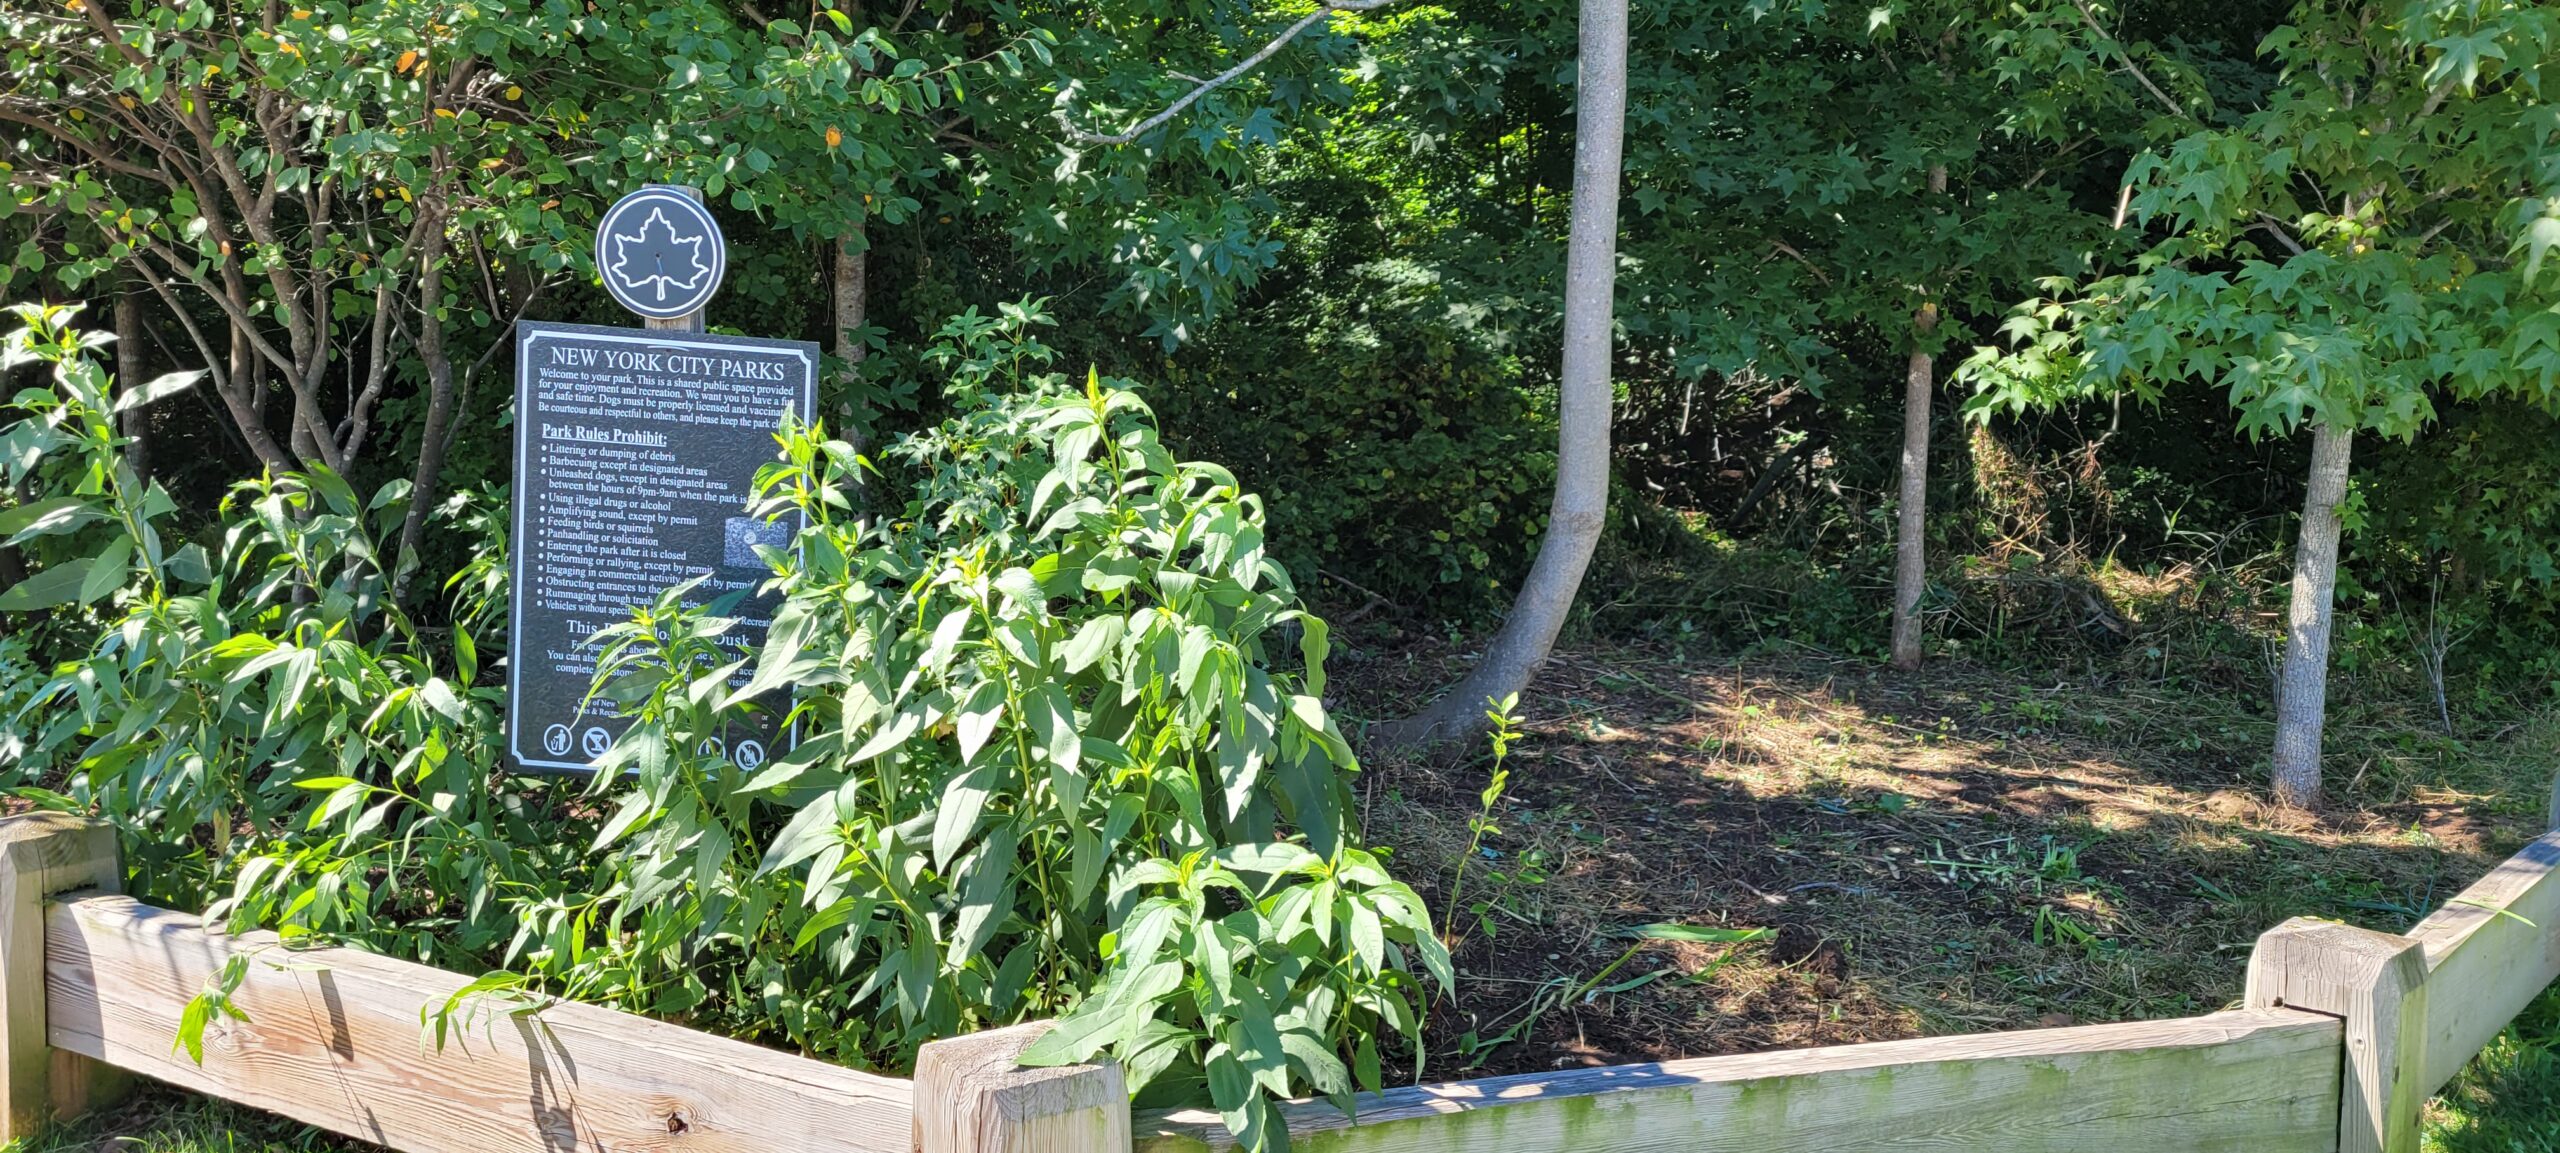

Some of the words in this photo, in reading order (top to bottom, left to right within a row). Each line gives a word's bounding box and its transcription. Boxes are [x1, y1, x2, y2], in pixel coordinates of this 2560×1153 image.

[551, 347, 599, 366] NEW
[604, 350, 663, 371] YORK
[668, 355, 716, 375] CITY
[721, 359, 784, 380] PARKS
[539, 379, 551, 388] for
[554, 382, 573, 391] your
[575, 383, 619, 394] enjoyment
[621, 386, 636, 394] and
[639, 388, 682, 399] recreation.
[686, 390, 699, 399] We
[702, 393, 721, 401] want
[724, 394, 739, 403] you
[752, 395, 771, 405] have
[540, 368, 578, 379] Welcome
[581, 372, 589, 380] to
[591, 374, 611, 383] your
[613, 374, 634, 384] park.
[637, 375, 655, 385] This
[658, 377, 665, 386] is
[674, 378, 701, 388] shared
[704, 381, 729, 391] public
[732, 384, 755, 394] space
[757, 385, 794, 396] provided
[539, 391, 554, 399] and
[556, 392, 573, 400] safe
[575, 393, 596, 402] time.
[599, 394, 621, 406] Dogs
[624, 398, 644, 406] must
[646, 398, 656, 407] be
[659, 399, 693, 412] properly
[696, 401, 729, 413] licensed
[732, 405, 747, 413] and
[749, 407, 786, 416] vaccinat
[539, 402, 549, 411] Be
[551, 403, 587, 414] courteous
[589, 406, 603, 415] and
[605, 408, 641, 418] respectful
[644, 411, 651, 419] to
[653, 410, 677, 422] others,
[680, 413, 693, 422] and
[696, 414, 718, 424] please
[720, 415, 738, 427] keep
[740, 417, 751, 426] the
[754, 420, 769, 429] park
[543, 423, 572, 438] Park
[576, 425, 609, 440] Rules
[614, 428, 667, 446] Prohibit:
[550, 444, 586, 456] Littering
[589, 448, 597, 456] or
[600, 447, 636, 460] dumping
[639, 450, 649, 459] of
[650, 450, 675, 461] debris
[550, 456, 597, 469] Barbecuing
[600, 462, 627, 472] except
[630, 461, 637, 470] in
[640, 462, 684, 475] designated
[686, 467, 707, 476] areas
[550, 468, 593, 479] Unleashed
[596, 471, 617, 483] dogs,
[620, 474, 647, 485] except
[650, 475, 657, 484] in
[660, 476, 704, 488] designated
[706, 480, 727, 489] areas
[549, 479, 583, 490] between
[586, 482, 599, 491] the
[601, 483, 624, 493] hours
[627, 486, 637, 494] of
[638, 486, 677, 499] 9pm-9am
[680, 491, 703, 500] when
[705, 491, 717, 501] the
[719, 494, 737, 504] park
[740, 495, 746, 503] is
[549, 493, 573, 505] Using
[576, 495, 601, 507] illegal
[604, 498, 627, 509] drugs
[641, 501, 671, 511] alcohol
[548, 505, 596, 519] Amplifying
[599, 510, 625, 520] sound,
[628, 513, 655, 523] except
[658, 513, 668, 524] by
[671, 516, 698, 525] permit
[548, 516, 581, 529] Feeding
[584, 519, 604, 530] birds
[618, 523, 653, 534] squirrels
[548, 528, 599, 543] Panhandling
[601, 534, 610, 542] or
[612, 534, 658, 546] solicitation
[547, 540, 582, 553] Entering
[585, 544, 597, 553] the
[600, 545, 618, 555] park
[621, 547, 640, 556] after
[642, 548, 648, 557] it
[651, 549, 657, 558] is
[660, 550, 686, 560] closed
[547, 552, 593, 566] Performing
[607, 558, 641, 570] rallying,
[644, 562, 671, 575] except
[674, 563, 683, 575] by
[686, 565, 713, 574] permit
[546, 564, 585, 578] Engaging
[589, 567, 596, 577] in
[599, 569, 646, 581] commercial
[650, 572, 681, 585] activity,
[714, 579, 723, 589] by
[546, 576, 595, 590] Obstructing
[597, 583, 636, 592] entrances
[638, 585, 646, 593] to
[649, 584, 661, 593] the
[546, 588, 596, 601] Rummaging
[599, 593, 630, 605] through
[633, 596, 653, 605] trash
[546, 600, 576, 611] Vehicles
[578, 603, 606, 613] without
[567, 620, 597, 634] This
[547, 650, 563, 659] You
[566, 652, 581, 660] can
[556, 664, 594, 674] complete
[593, 698, 599, 706] of
[601, 699, 615, 707] New
